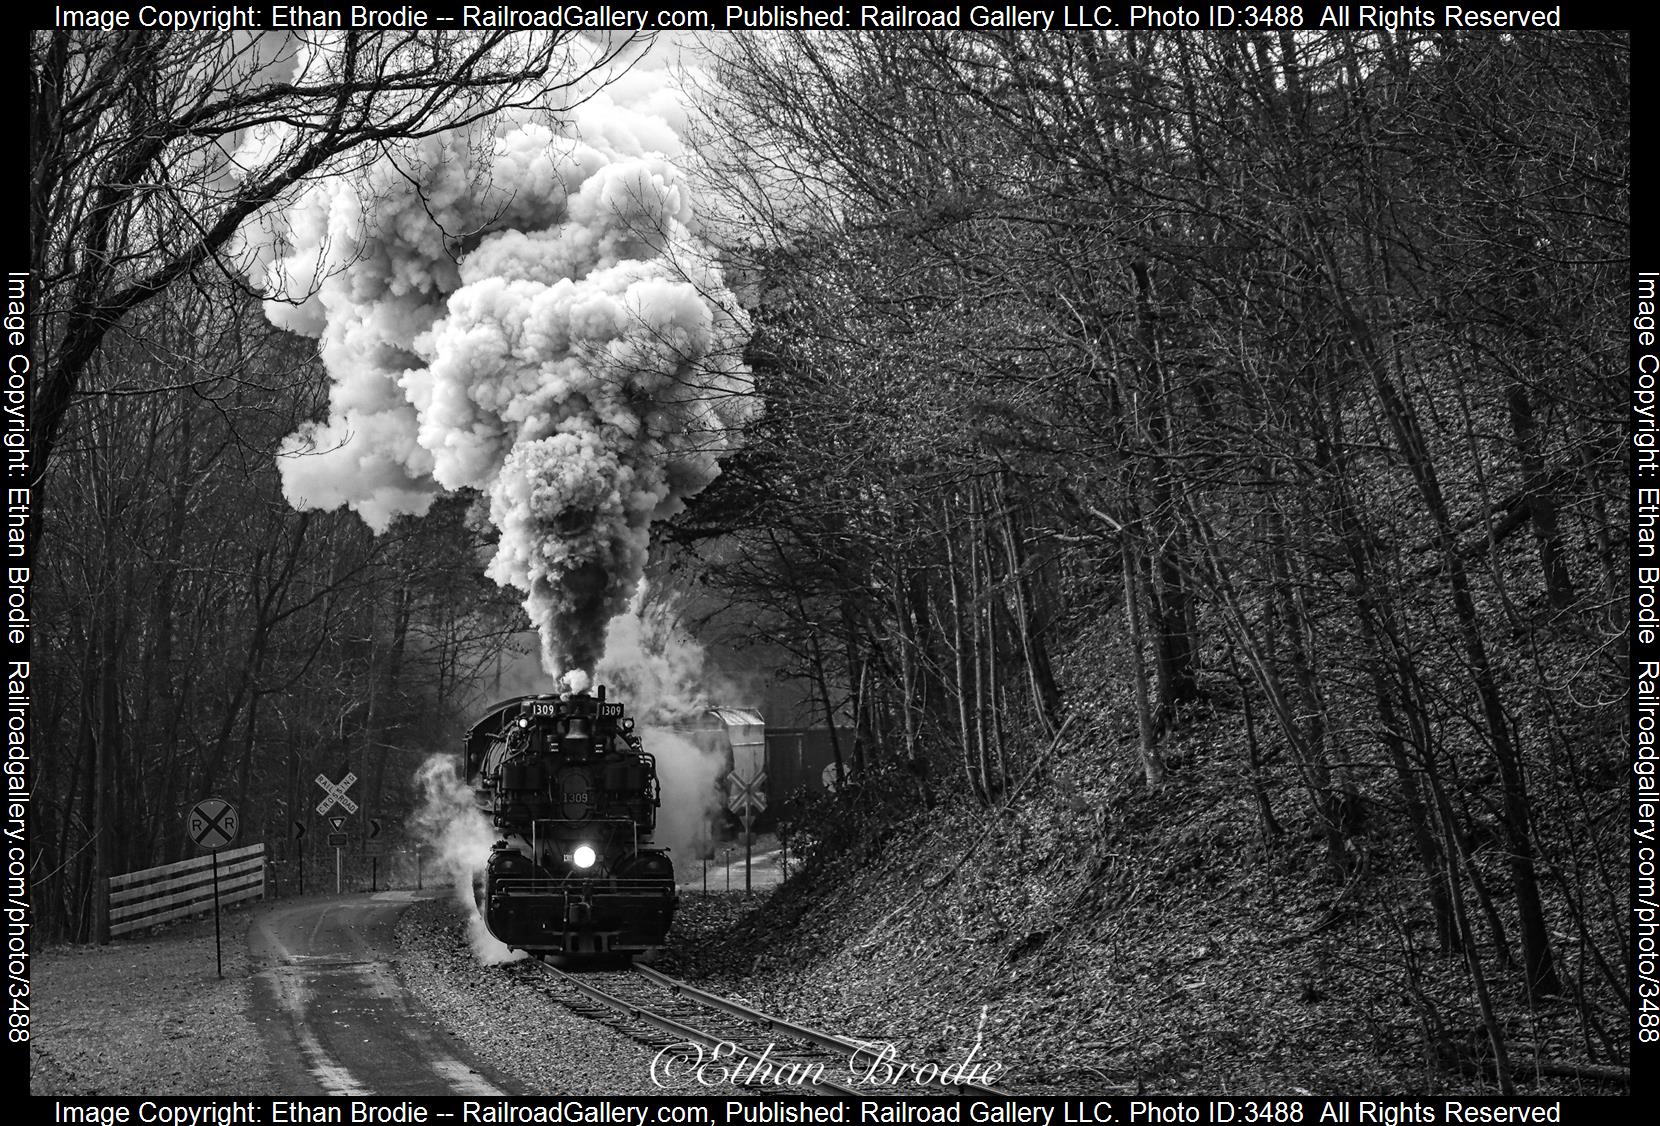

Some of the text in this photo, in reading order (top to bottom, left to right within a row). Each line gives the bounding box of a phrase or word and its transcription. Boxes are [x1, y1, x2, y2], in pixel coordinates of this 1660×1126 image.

[533, 704, 554, 715] 1309
[602, 705, 621, 716] 1309
[318, 774, 355, 814] CROSSING
[563, 792, 588, 803] 1309
[193, 818, 234, 831] R R
